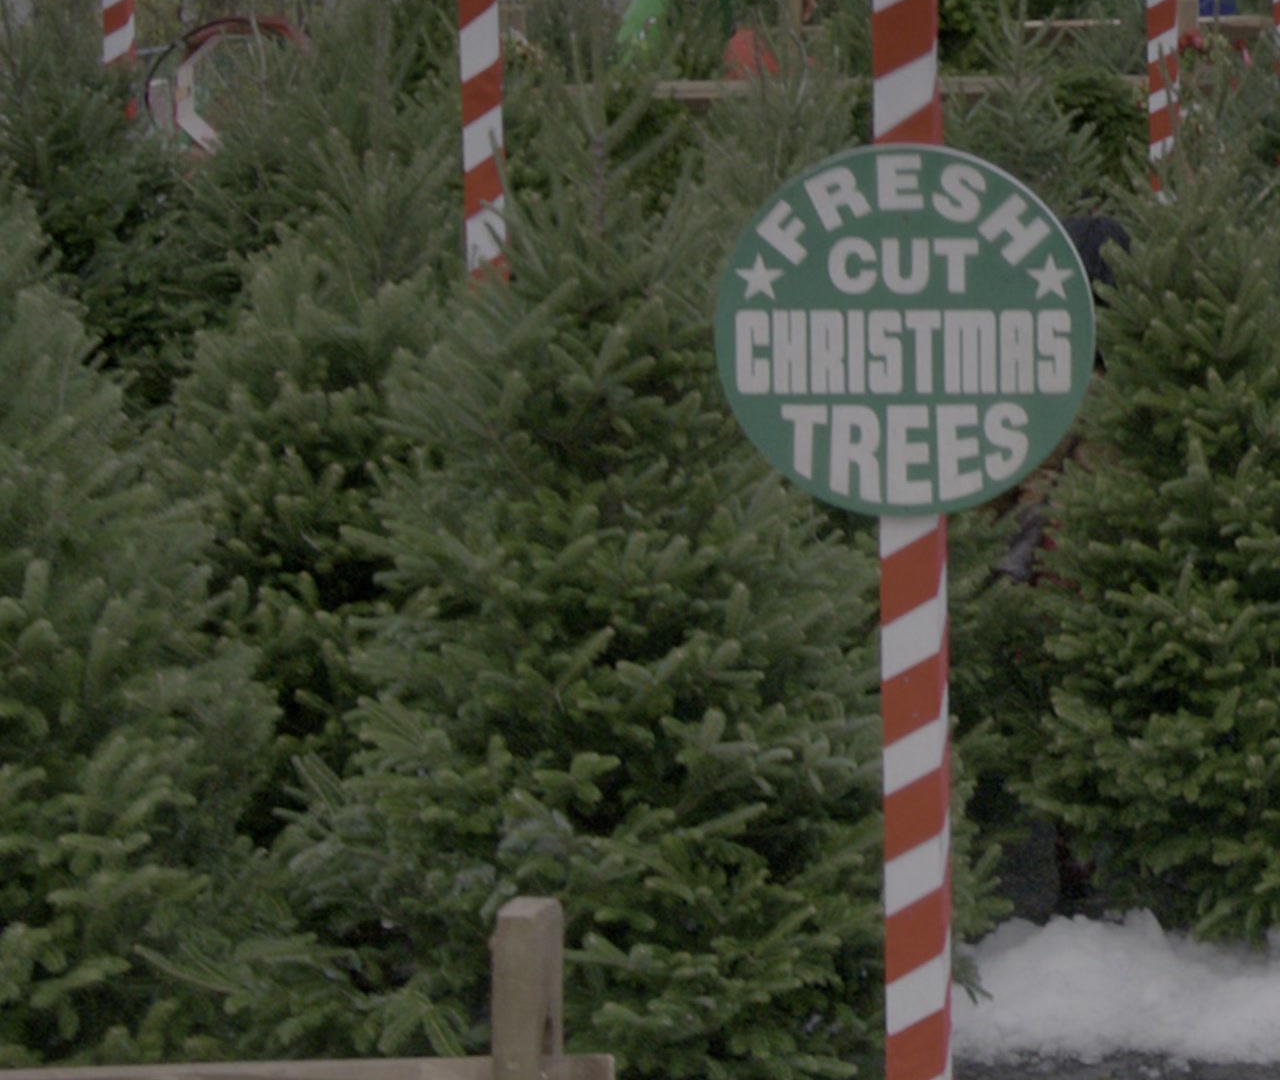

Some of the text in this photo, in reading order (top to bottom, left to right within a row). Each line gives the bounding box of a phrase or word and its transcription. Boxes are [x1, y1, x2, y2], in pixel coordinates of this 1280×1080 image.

[755, 154, 1051, 266] FRESH
[827, 236, 979, 295] CUT
[735, 309, 1072, 394] CHRISTMAS
[780, 401, 1030, 506] TREES
